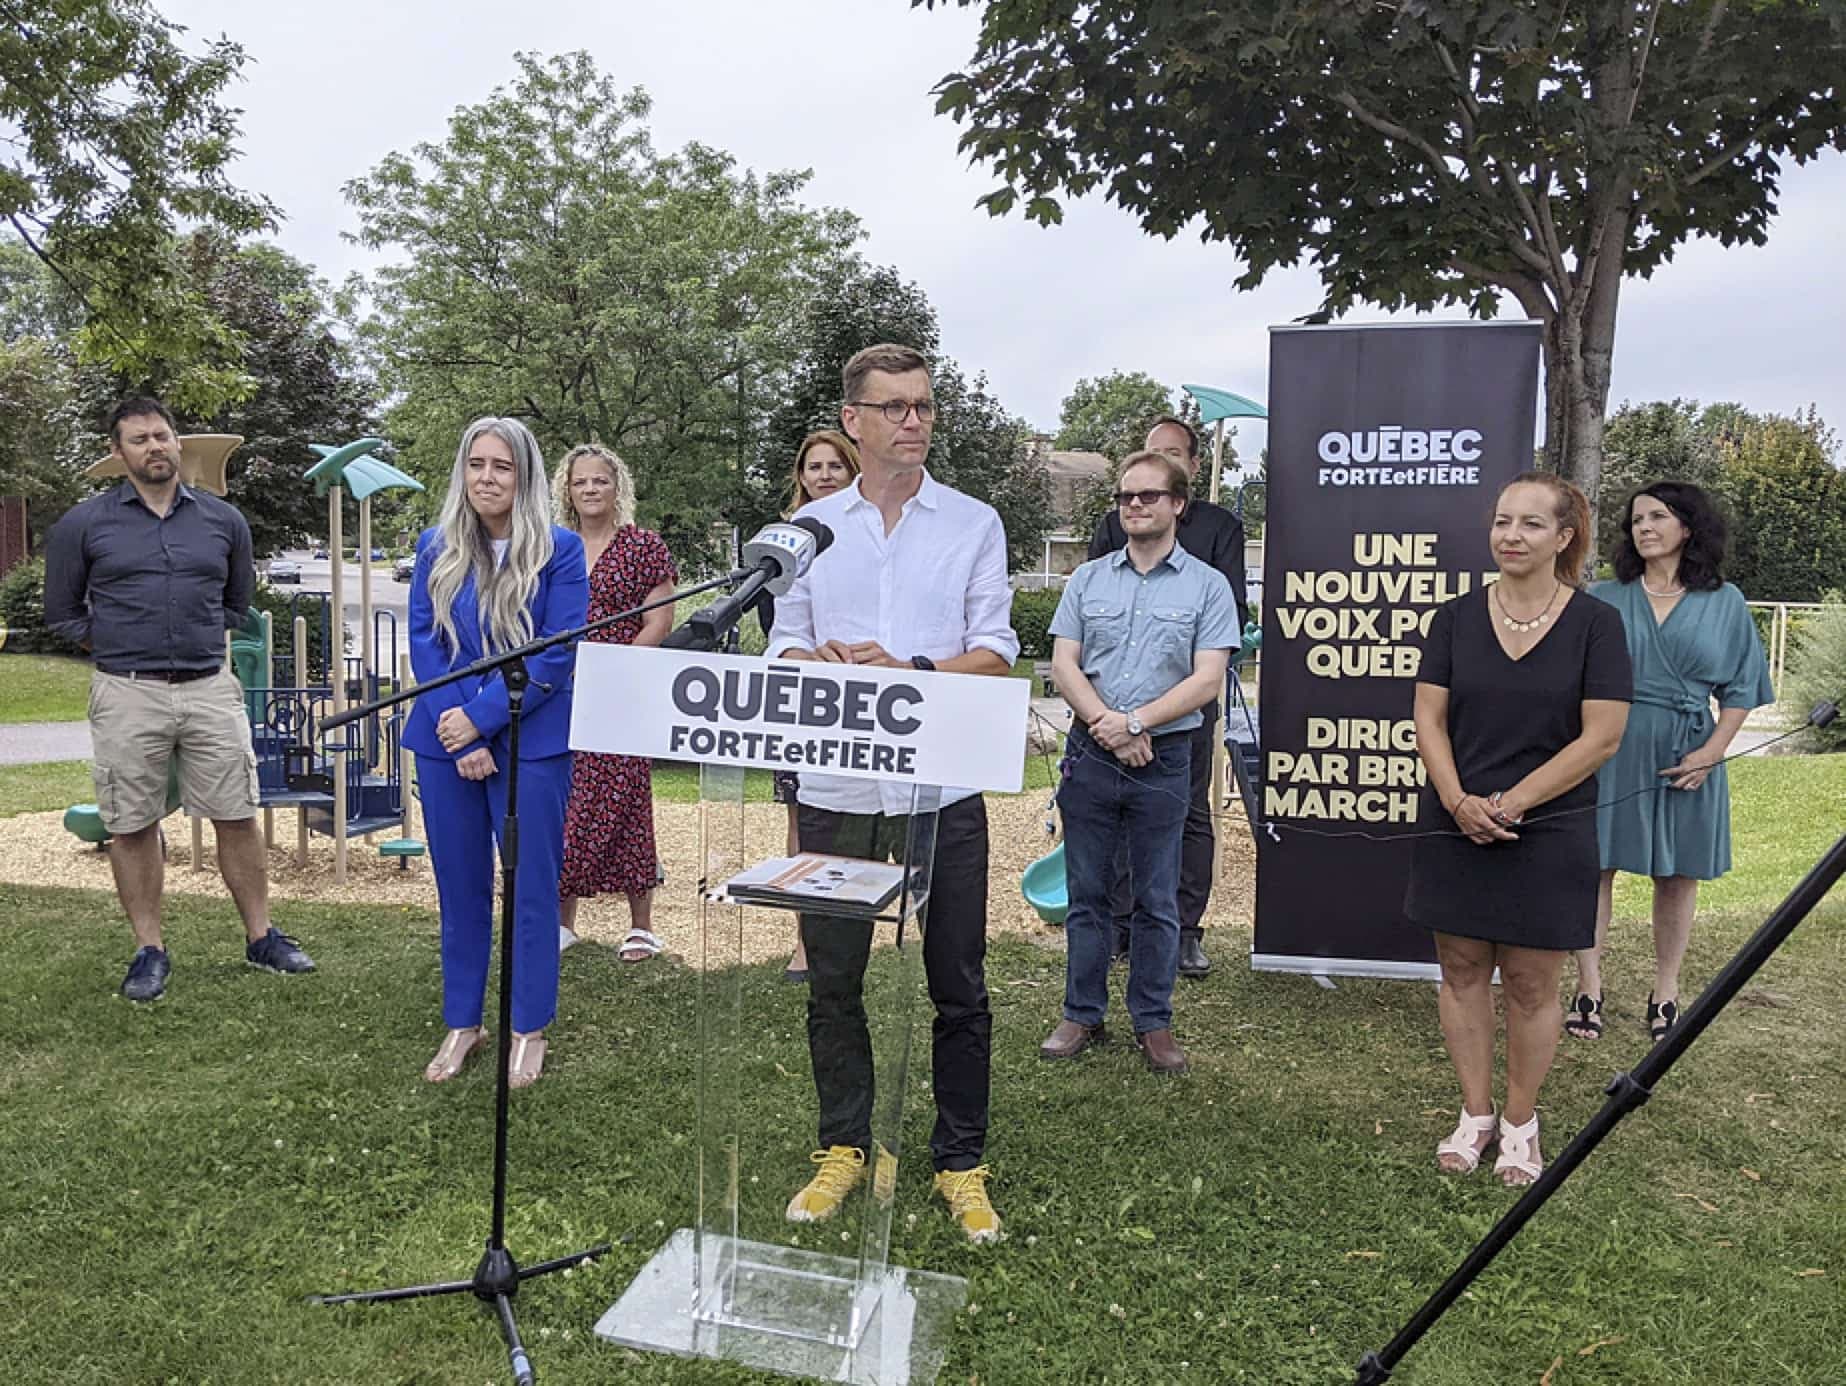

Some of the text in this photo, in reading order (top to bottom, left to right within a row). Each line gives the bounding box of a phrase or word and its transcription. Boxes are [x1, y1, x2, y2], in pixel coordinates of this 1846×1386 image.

[1354, 533, 1438, 566] UNE
[1275, 607, 1382, 640] VOIX
[1307, 717, 1417, 751] DIRIG
[1268, 751, 1349, 785] PAR
[1264, 786, 1419, 823] MARCH
